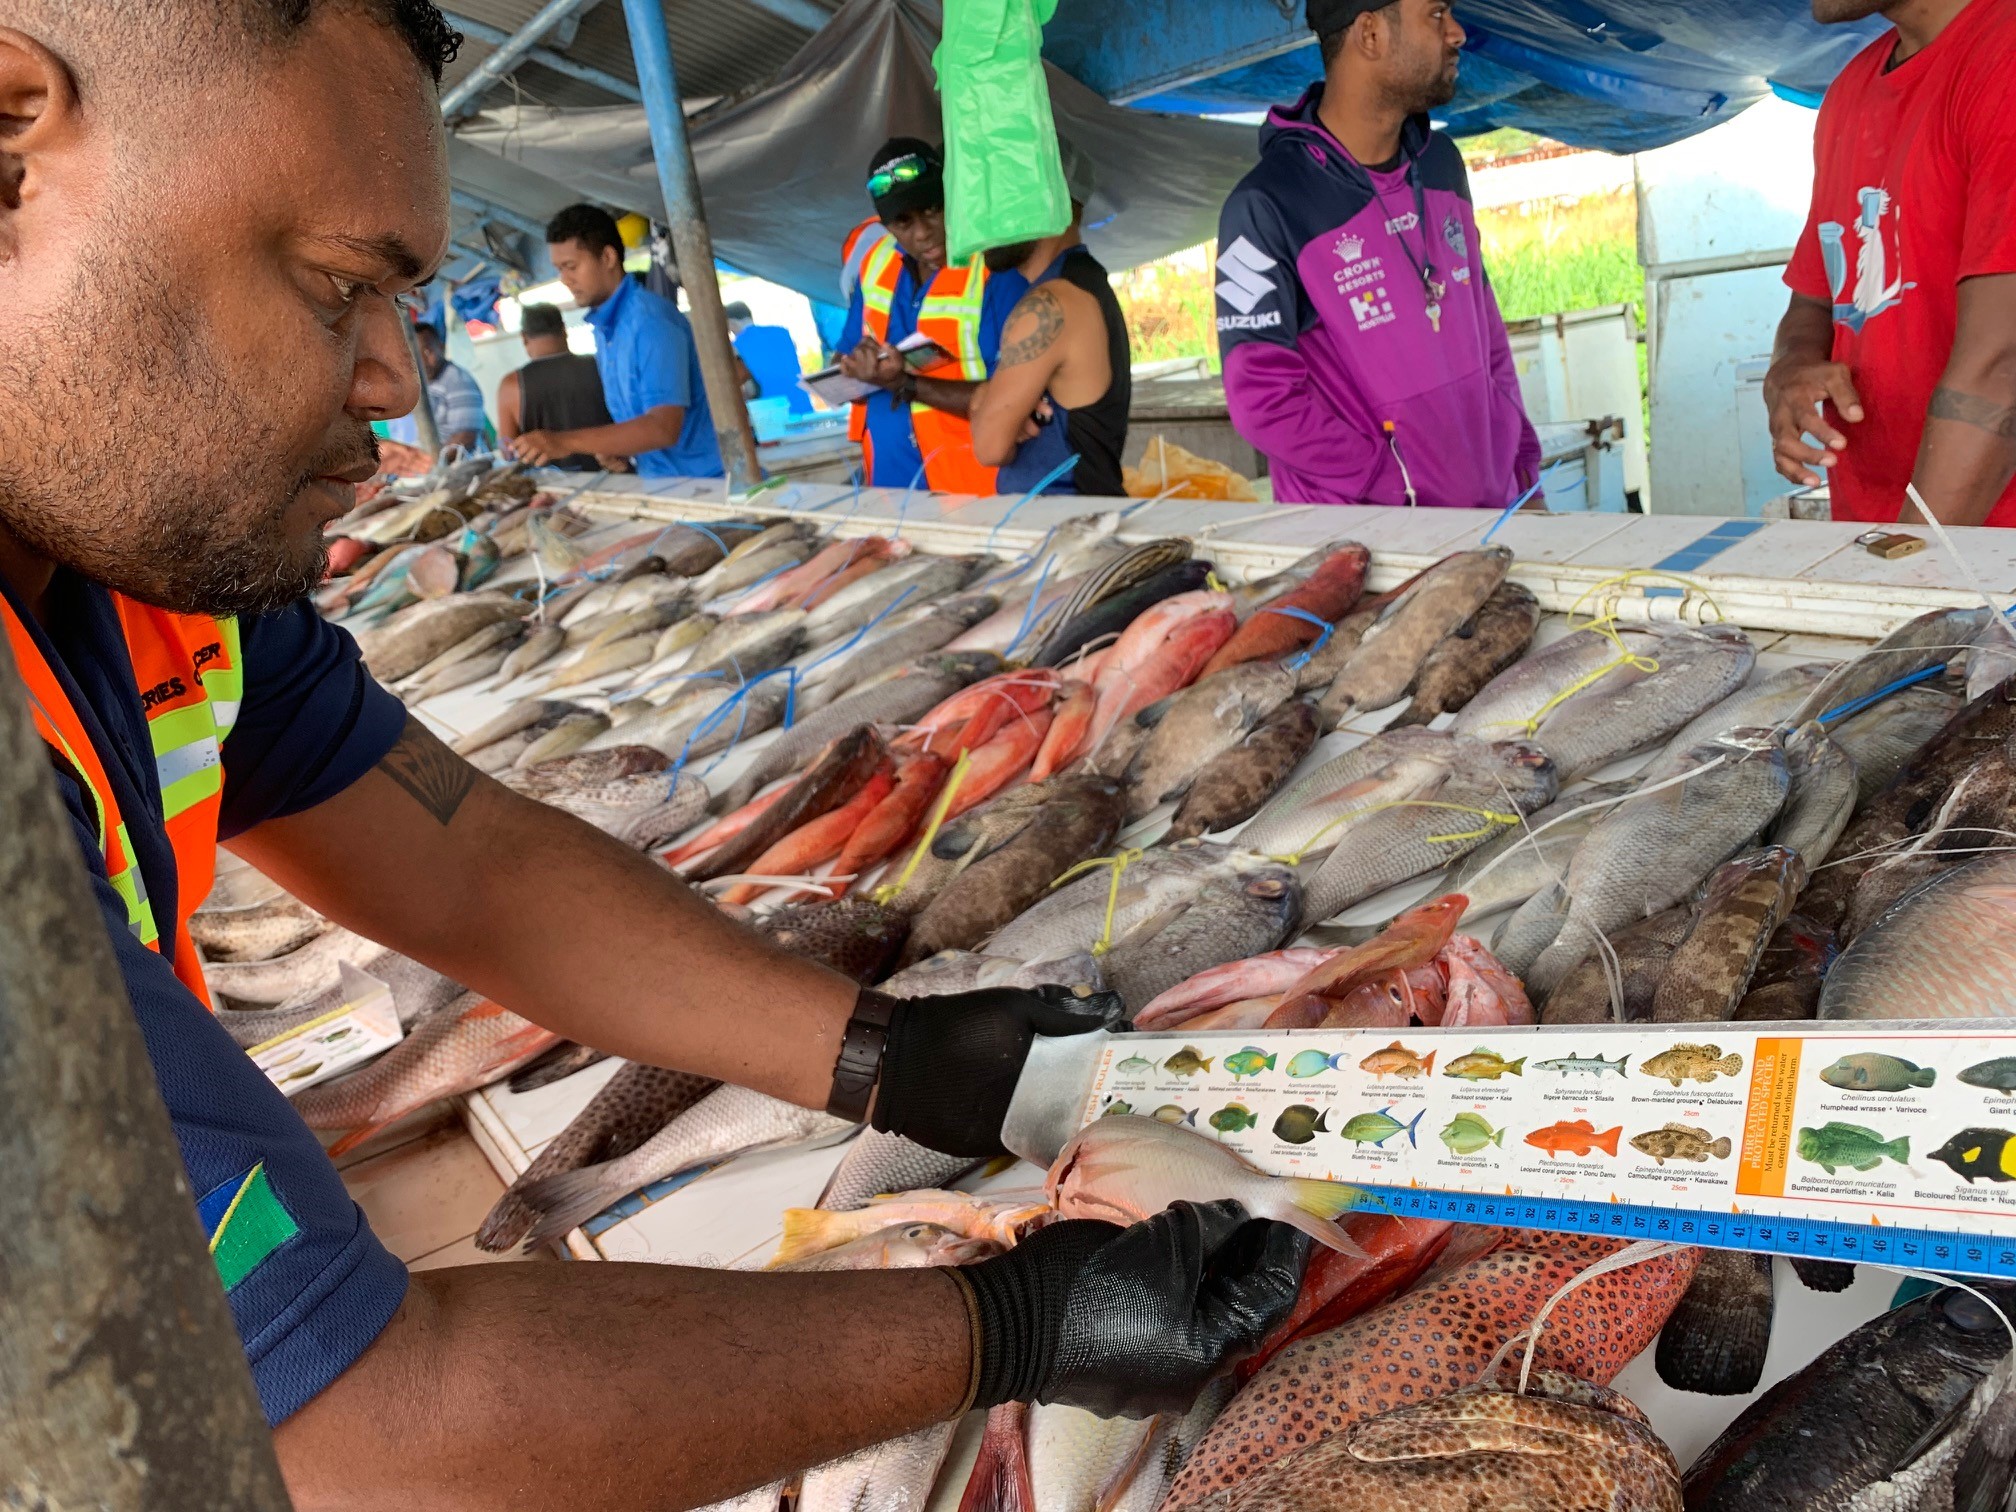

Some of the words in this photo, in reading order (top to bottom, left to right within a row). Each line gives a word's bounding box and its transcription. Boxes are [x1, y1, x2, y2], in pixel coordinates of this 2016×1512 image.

[1333, 256, 1381, 283] CROWN
[1337, 270, 1386, 296] RESORTS
[1216, 310, 1281, 331] SUZUKI
[1779, 1053, 1788, 1078] water
[1788, 1056, 1798, 1080] harm.
[1085, 1094, 1100, 1123] FISH
[1095, 1049, 1114, 1091] RULER
[1776, 1078, 1784, 1091] the
[1653, 1089, 1690, 1097] Epinephelus
[1775, 1092, 1782, 1101] to
[1785, 1080, 1794, 1113] without
[1841, 1094, 1876, 1102] Cheilinus
[1743, 1086, 1762, 1162] THREATENED
[1755, 1059, 1766, 1084] AND
[1752, 1101, 1769, 1169] PROTECTED
[1762, 1055, 1776, 1098] SPECIES
[1820, 1104, 1858, 1112] Humphead
[1896, 1106, 1927, 1114] Varivoce
[1989, 1107, 2011, 1115] Giant
[1771, 1101, 1781, 1137] returned
[1782, 1114, 1790, 1129] and
[1768, 1138, 1776, 1151] be
[1778, 1134, 1789, 1169] carefully
[1765, 1151, 1774, 1172] Must
[1635, 1166, 1672, 1175] Epinephelus
[1628, 1172, 1662, 1181] Camouflage
[1664, 1174, 1687, 1182] grouper
[1695, 1177, 1728, 1185] Kawakawa
[1801, 1176, 1854, 1187] Bolbometopon
[1855, 1180, 1897, 1189] muricatum
[1791, 1184, 1829, 1193] Bumphead
[1877, 1190, 1895, 1198] Kalia
[1915, 1191, 1956, 1200] Bicoloured
[1955, 1186, 1988, 1195] Siganus
[1990, 1188, 2009, 1196] uspi
[1394, 1197, 1403, 1207] 25
[1411, 1198, 1420, 1209] 26
[1429, 1200, 1438, 1211] 27
[1448, 1202, 1457, 1212] 28
[1466, 1203, 1476, 1214] 29
[1485, 1205, 1496, 1216] 30
[1505, 1207, 1516, 1217] 31
[1525, 1208, 1536, 1219] 32
[1546, 1210, 1557, 1221] 33
[1567, 1211, 1579, 1223] 34
[1589, 1213, 1601, 1225] 35
[1611, 1214, 1623, 1227] 36
[1634, 1217, 1646, 1229] 37
[1658, 1219, 1670, 1231] 38
[1682, 1221, 1694, 1234] 39
[1707, 1224, 1720, 1236] 40
[1732, 1227, 1746, 1238] 41
[1759, 1228, 1773, 1241] 42
[1787, 1231, 1800, 1244] 43
[1814, 1233, 1828, 1247] 44
[1843, 1237, 1858, 1250] 45
[1873, 1239, 1887, 1253] 46
[1903, 1242, 1918, 1256] 47
[1934, 1245, 1950, 1259] 48
[1967, 1248, 1983, 1262] 49
[2000, 1252, 2016, 1266] 50
